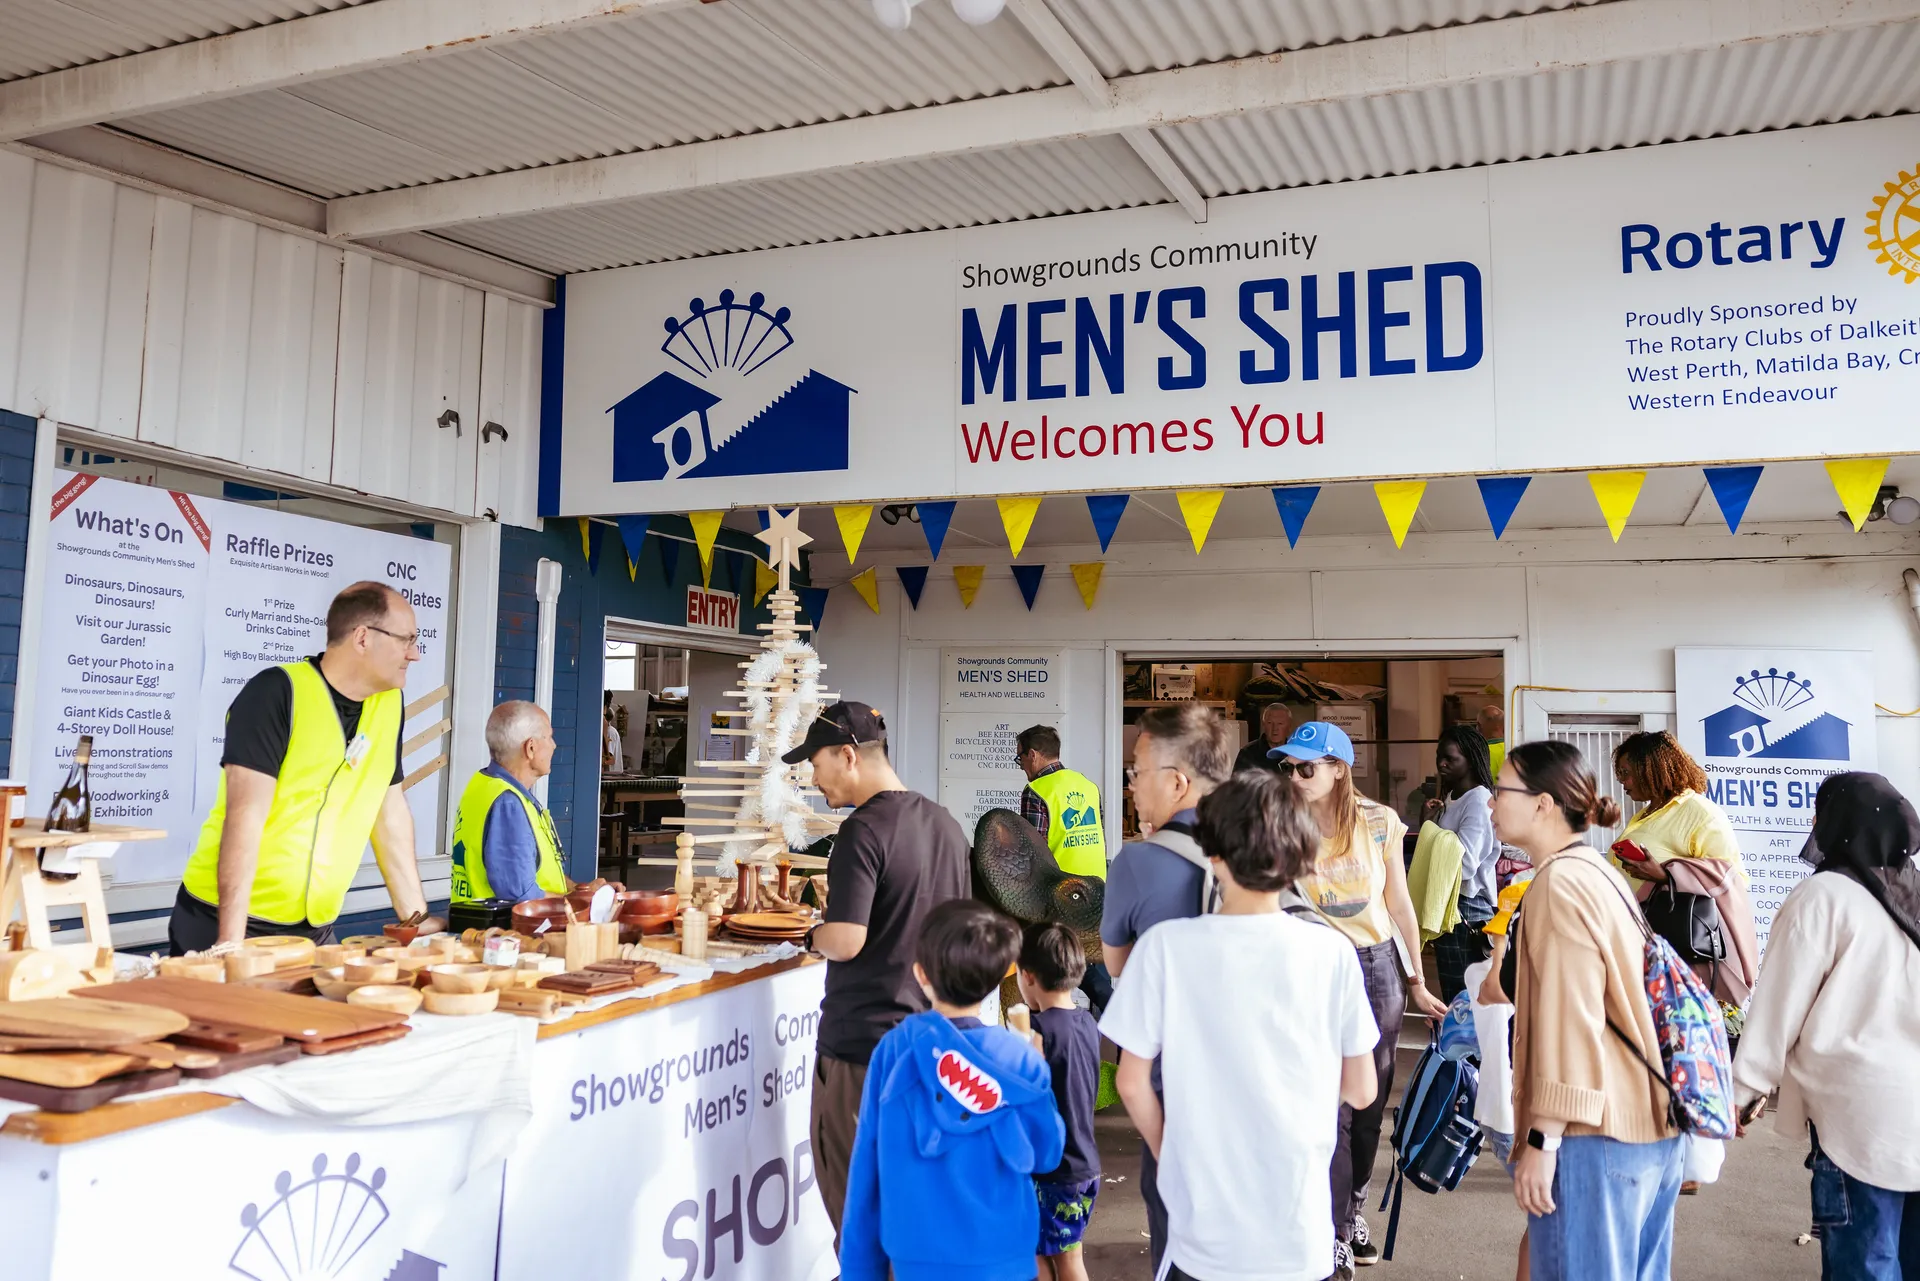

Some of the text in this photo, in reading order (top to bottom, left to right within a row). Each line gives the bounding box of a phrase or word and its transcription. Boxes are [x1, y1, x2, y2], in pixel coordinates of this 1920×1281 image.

[1621, 217, 1846, 274] Rotary
[962, 231, 1318, 289] Showgrounds Community
[1625, 295, 1857, 328] Proudly Sponsored by
[1238, 261, 1485, 385] SHED
[1626, 338, 1663, 355] The
[1671, 334, 1739, 353] Rotary
[1745, 328, 1803, 348] Clubs
[1810, 324, 1832, 342] of
[1627, 365, 1679, 383] West
[1686, 359, 1748, 381] Perth,
[1756, 354, 1839, 375] Matilda
[1847, 353, 1891, 371] Bay,
[1628, 385, 1838, 411] Western Endeavour
[961, 404, 1325, 464] Welcomes You
[75, 508, 183, 544] What's On
[118, 541, 140, 551] at the
[227, 533, 334, 567] Raffle Prizes
[56, 542, 111, 558] Showgrounds
[112, 551, 155, 564] Community
[177, 559, 195, 569] Shed
[229, 558, 260, 569] Exquisite
[260, 562, 283, 571] Artisan
[284, 565, 303, 575] Works
[386, 561, 417, 581] CNC
[65, 573, 185, 599] Dinosaurs, Dinosaurs,
[95, 593, 156, 610] Dinosaurs!
[274, 600, 295, 610] Prize
[401, 588, 442, 609] Plates
[225, 607, 249, 620] Curly
[251, 610, 275, 621] Marri
[275, 614, 292, 623] and
[688, 591, 739, 629] ENTRY
[75, 614, 172, 634] Visit our Jurassic
[246, 623, 311, 638] Drinks Cabinet
[100, 633, 146, 647] Garden!
[422, 627, 437, 639] cut
[275, 642, 294, 652] Prize
[67, 654, 174, 671] Get your Photo in a
[223, 650, 241, 661] High
[242, 651, 257, 662] Boy
[258, 653, 295, 663] Blackbutt
[957, 657, 1049, 667] Showgrounds Community
[81, 672, 160, 688] Dinosaur Egg!
[221, 676, 245, 685] Jarrah
[957, 670, 1048, 683] MEN'S SHED
[63, 706, 172, 720] Giant Kids Castle &
[56, 722, 174, 736] 4-Storey Doll House!
[955, 738, 991, 746] BICYCLES
[54, 746, 173, 758] Live emonstrations
[949, 753, 994, 761] COMPUTING
[87, 771, 123, 779] hroughout
[1704, 764, 1782, 775] Showgrounds
[162, 790, 170, 800] &
[1787, 780, 1816, 808] SH
[94, 805, 153, 817] Exhibition
[1727, 815, 1761, 825] EALTH
[1765, 817, 1772, 825] &
[1769, 839, 1792, 848] ART
[1769, 869, 1810, 880] KEEPIN
[570, 1027, 749, 1122] Showgrounds
[684, 1055, 805, 1139] Men's Shed
[661, 1138, 816, 1281] SHOP
